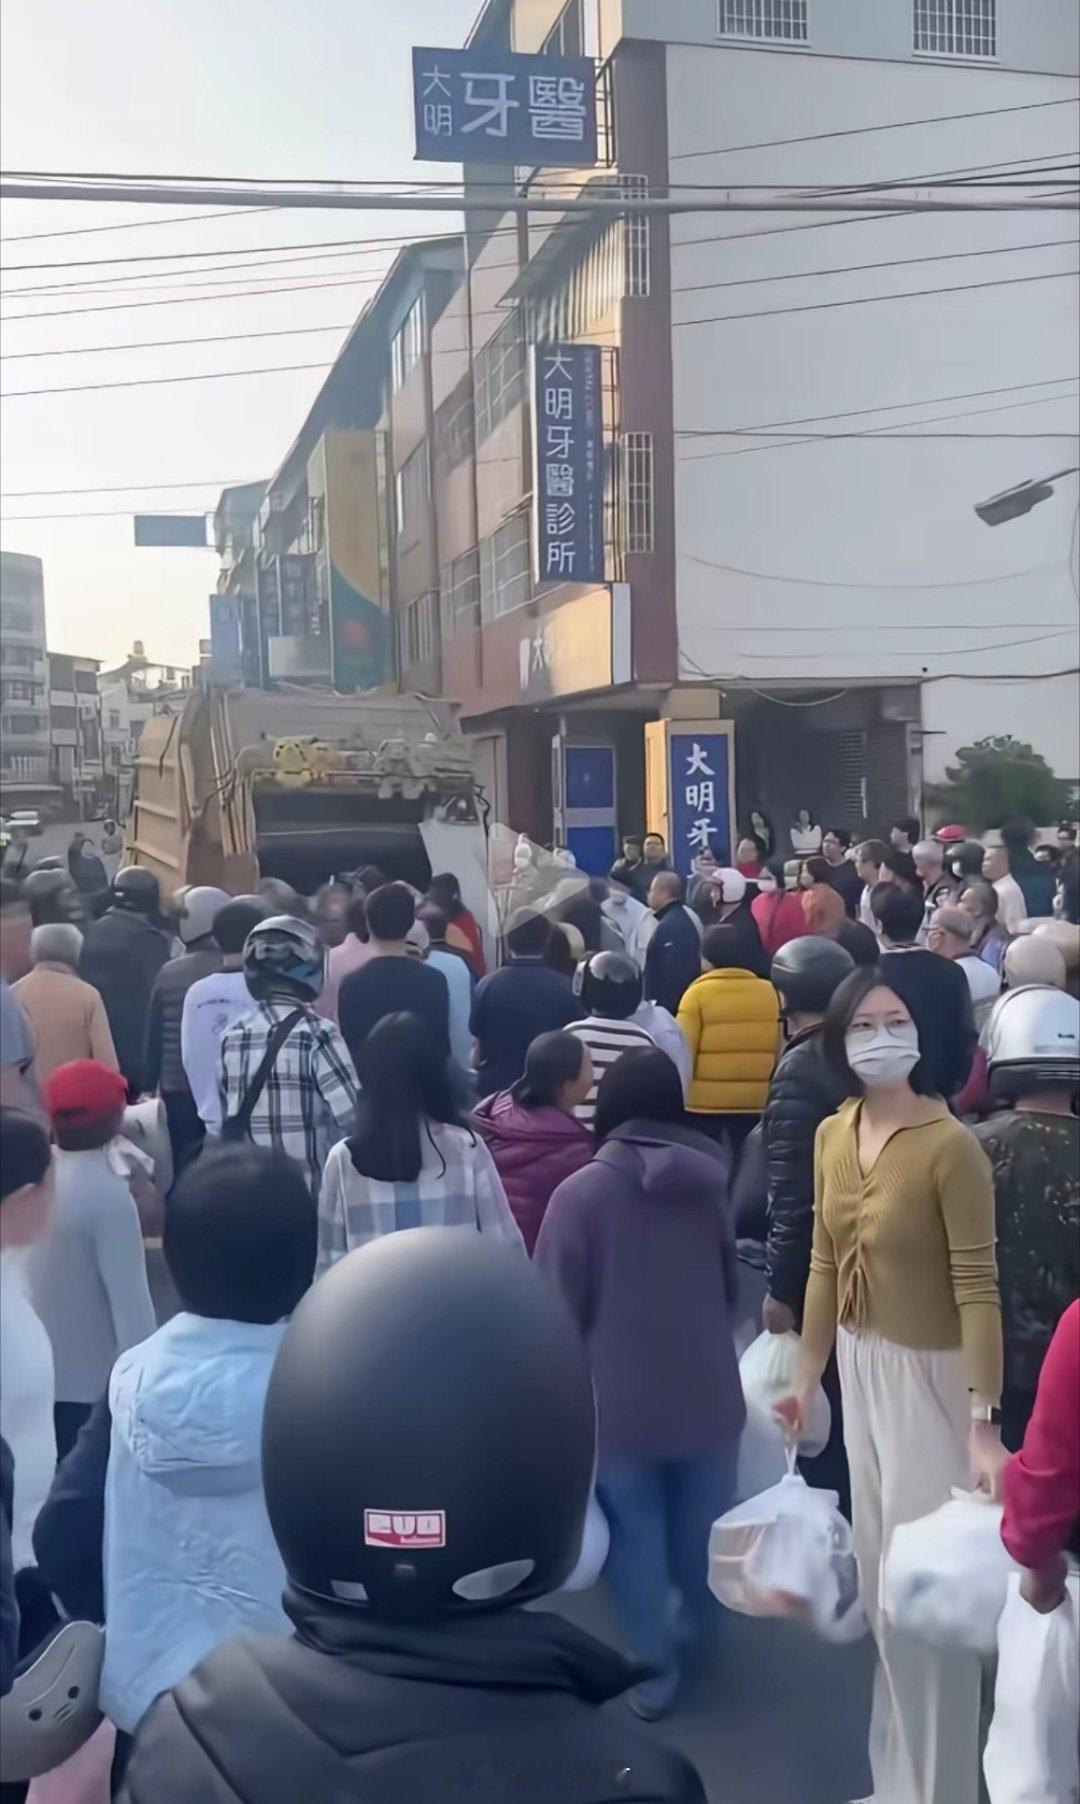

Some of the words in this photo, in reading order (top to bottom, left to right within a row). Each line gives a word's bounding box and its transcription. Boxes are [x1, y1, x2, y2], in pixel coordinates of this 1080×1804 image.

[422, 65, 452, 136] 大明
[460, 72, 586, 140] 牙醫
[544, 350, 575, 573] 大明牙醫診所
[685, 743, 718, 878] 大明牙
